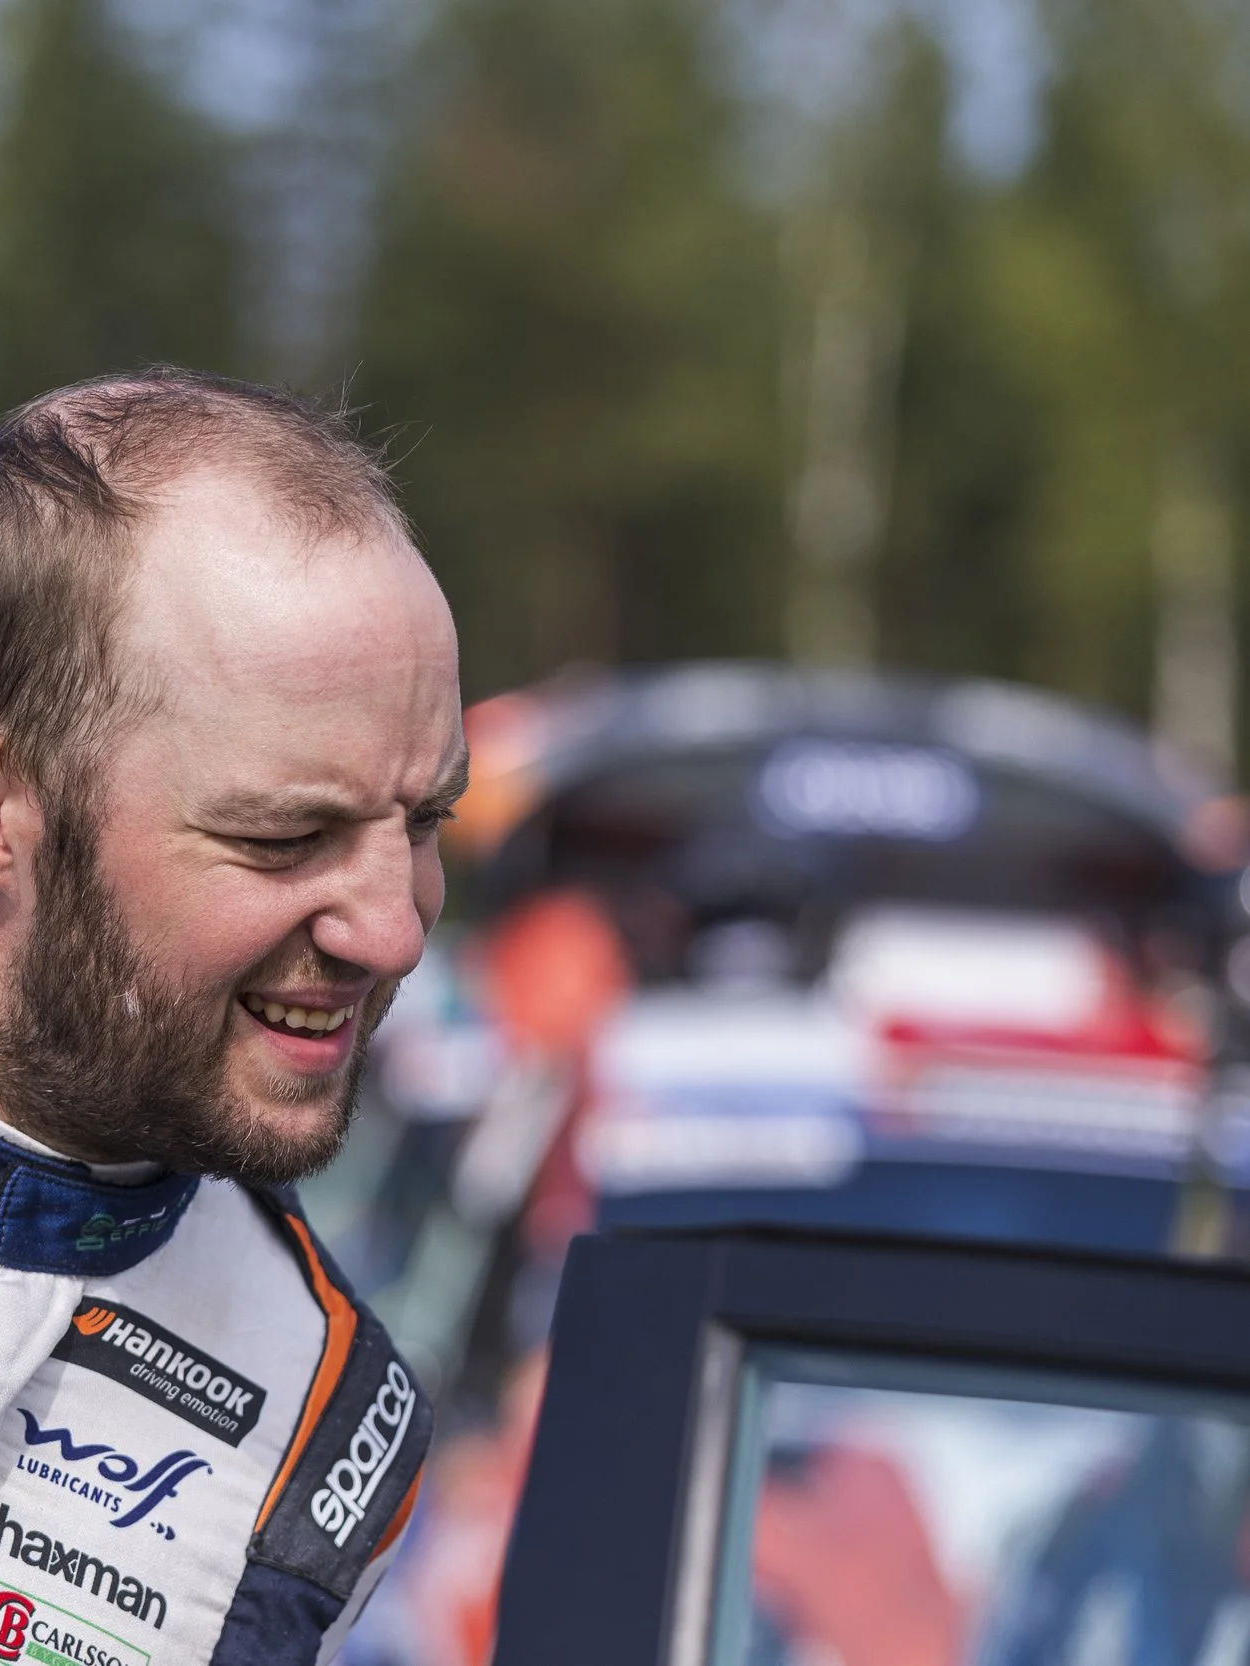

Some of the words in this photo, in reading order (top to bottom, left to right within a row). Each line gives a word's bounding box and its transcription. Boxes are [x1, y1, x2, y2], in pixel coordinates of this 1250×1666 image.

[129, 1362, 181, 1401] driving
[179, 1392, 239, 1433] emotion
[16, 1454, 123, 1513] LUBRICANTS
[311, 1361, 412, 1536] sparco
